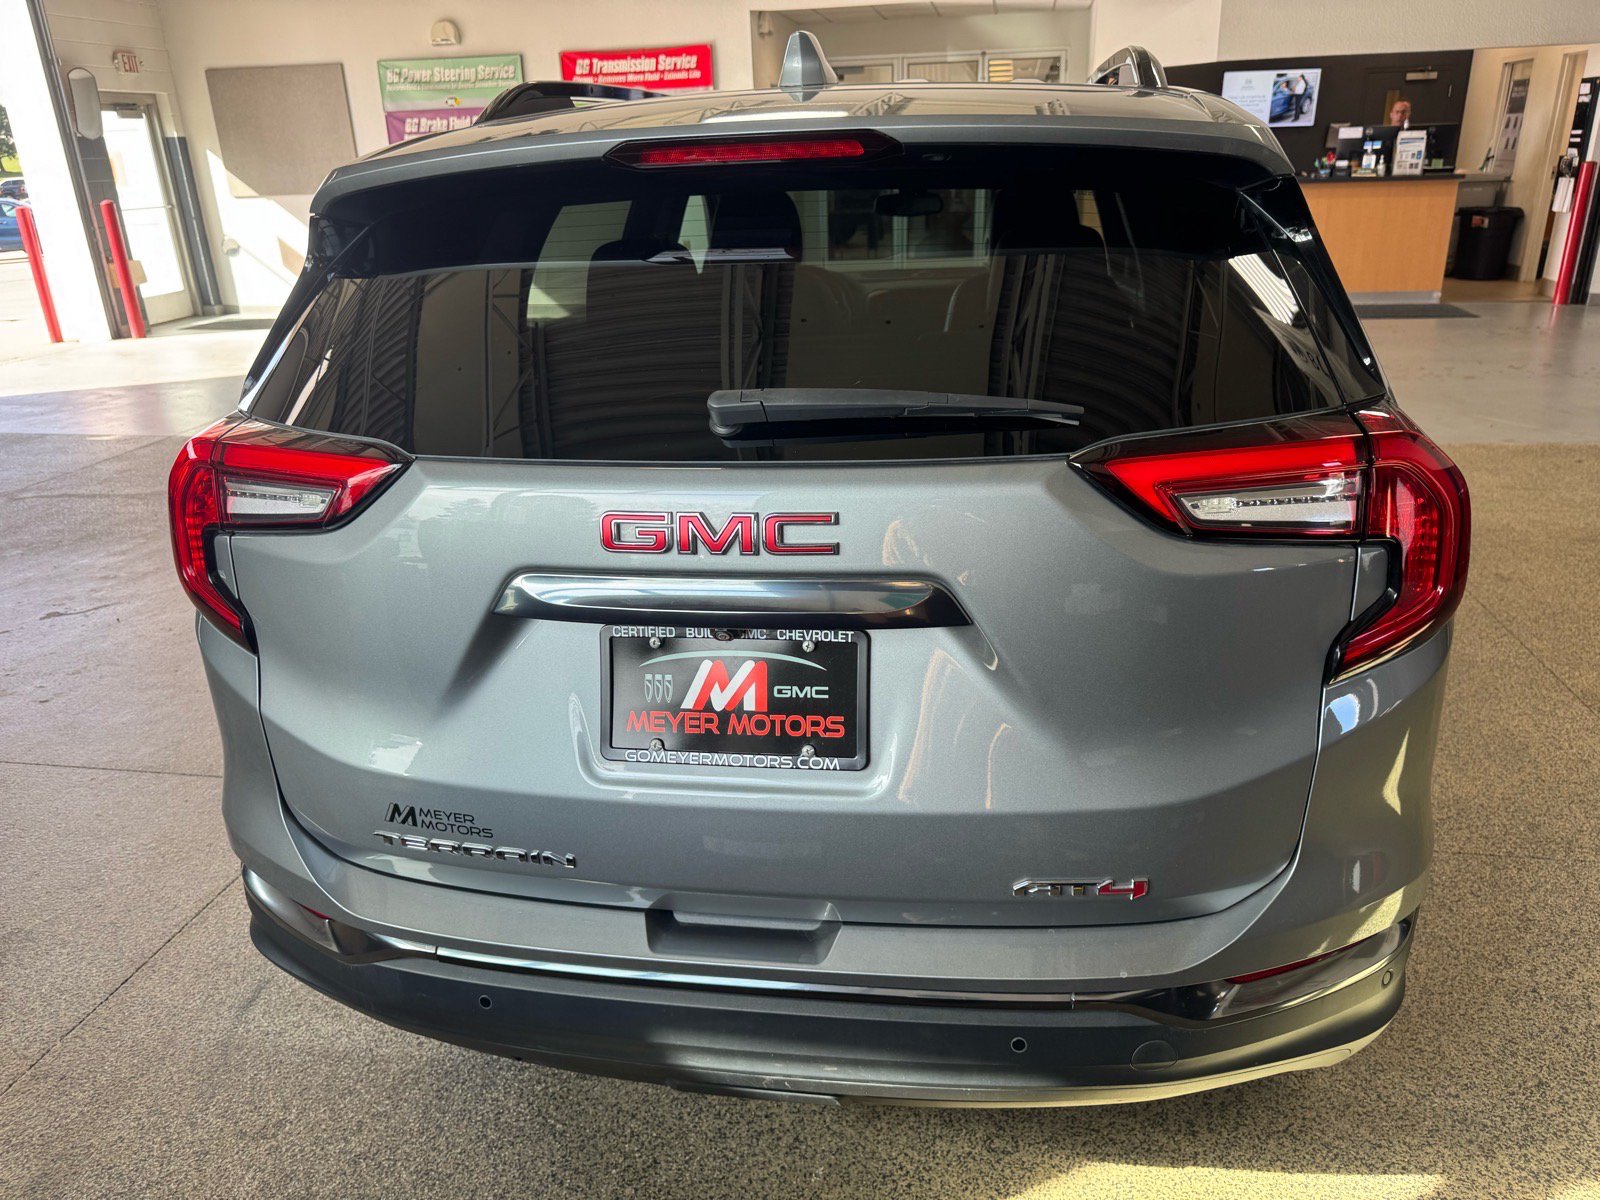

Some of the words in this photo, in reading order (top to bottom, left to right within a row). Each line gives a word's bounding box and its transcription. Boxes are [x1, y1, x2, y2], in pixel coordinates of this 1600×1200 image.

[121, 54, 139, 73] EXIT
[592, 56, 656, 73] Transmission
[658, 54, 697, 70] Service
[386, 67, 401, 83] BG
[401, 67, 433, 83] Power
[434, 65, 477, 83] Steering
[477, 65, 515, 80] Service
[627, 71, 644, 82] More
[644, 70, 660, 81] Fluid
[663, 70, 689, 80] Extends
[689, 69, 702, 79] Life
[419, 116, 448, 133] Brake
[448, 115, 471, 130] Fluid
[600, 510, 840, 555] GMC
[612, 626, 676, 639] CERTIFIED
[685, 627, 714, 639] BUI
[741, 628, 767, 640] MC
[777, 629, 855, 643] CHEVROLET
[773, 685, 829, 699] GMC
[626, 711, 720, 735] MEYER
[727, 715, 845, 738] MOTORS
[624, 749, 840, 770] GOMEYERMOTORS.COM
[418, 807, 475, 825] MEYER
[421, 819, 494, 839] MOTORS
[372, 830, 577, 869] TERRAIN
[1012, 877, 1150, 900] AT4
